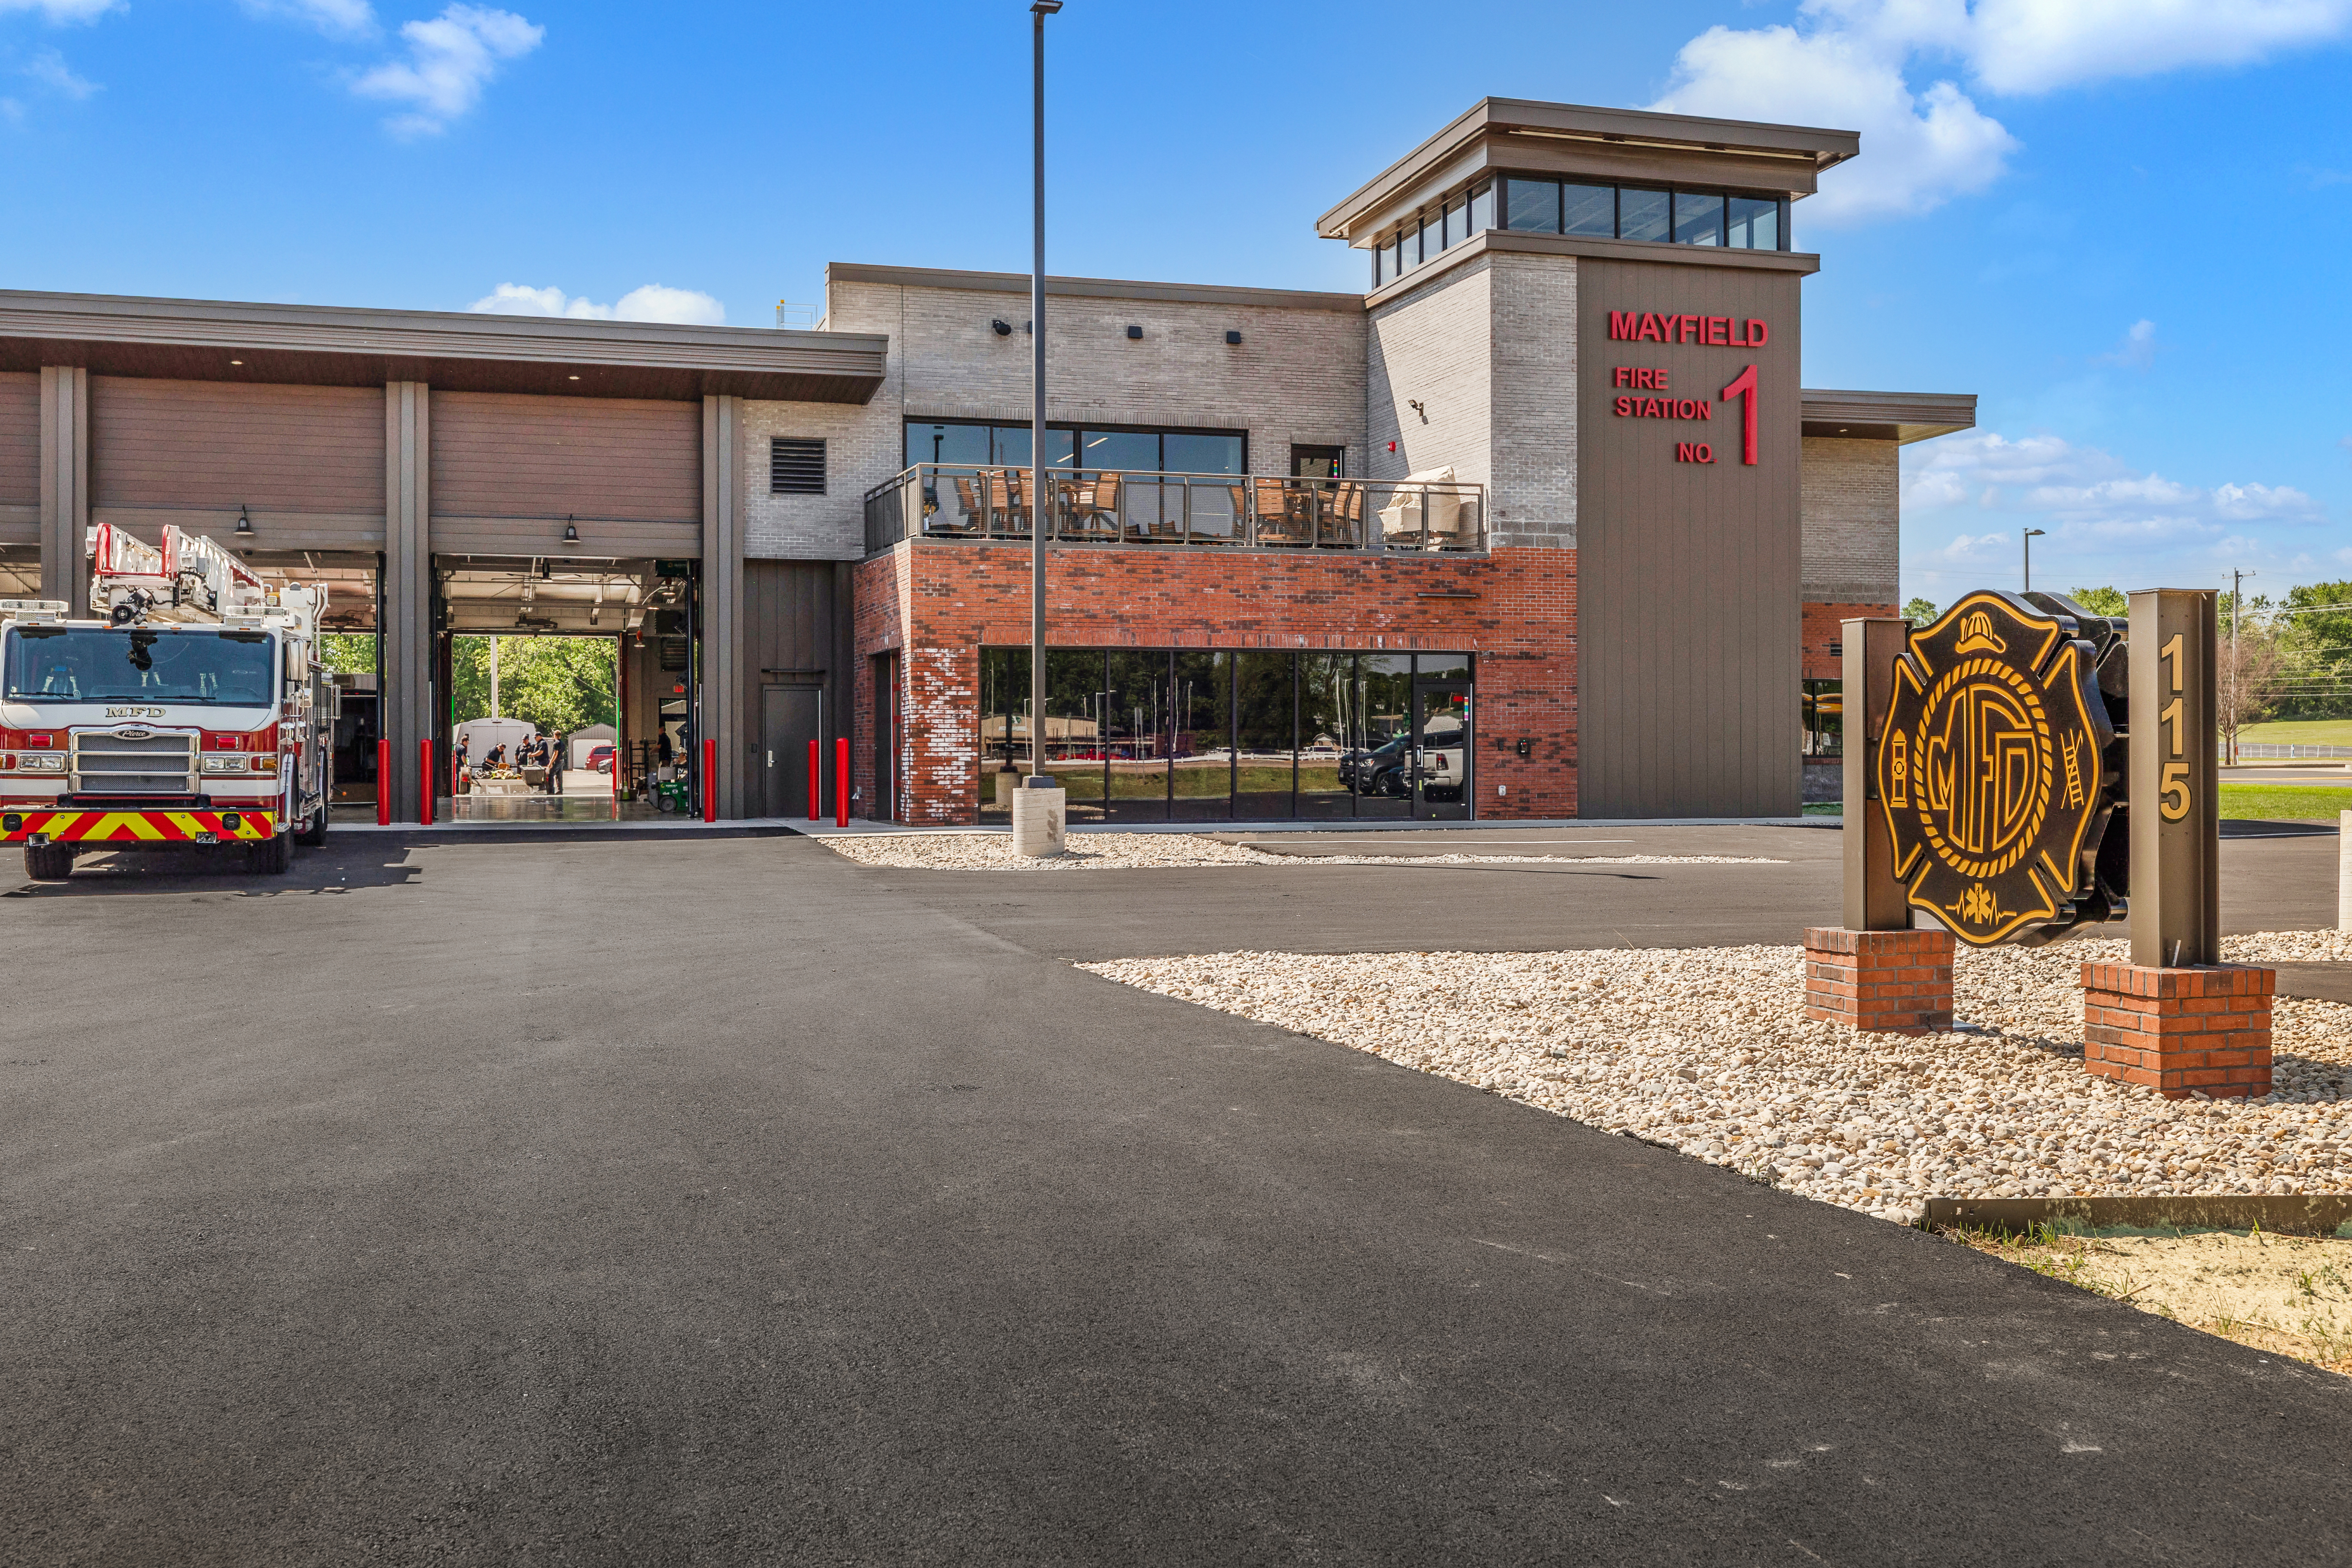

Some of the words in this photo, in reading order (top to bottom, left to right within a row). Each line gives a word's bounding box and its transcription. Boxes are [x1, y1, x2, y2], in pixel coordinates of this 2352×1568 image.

[1610, 311, 1768, 347] MAYFIELD
[1616, 367, 1669, 389] FIRE
[1616, 396, 1711, 420] STATION
[1723, 364, 1758, 465] 1
[1678, 442, 1718, 463] NO.
[105, 707, 166, 717] MFD
[1926, 683, 2038, 854] MFD
